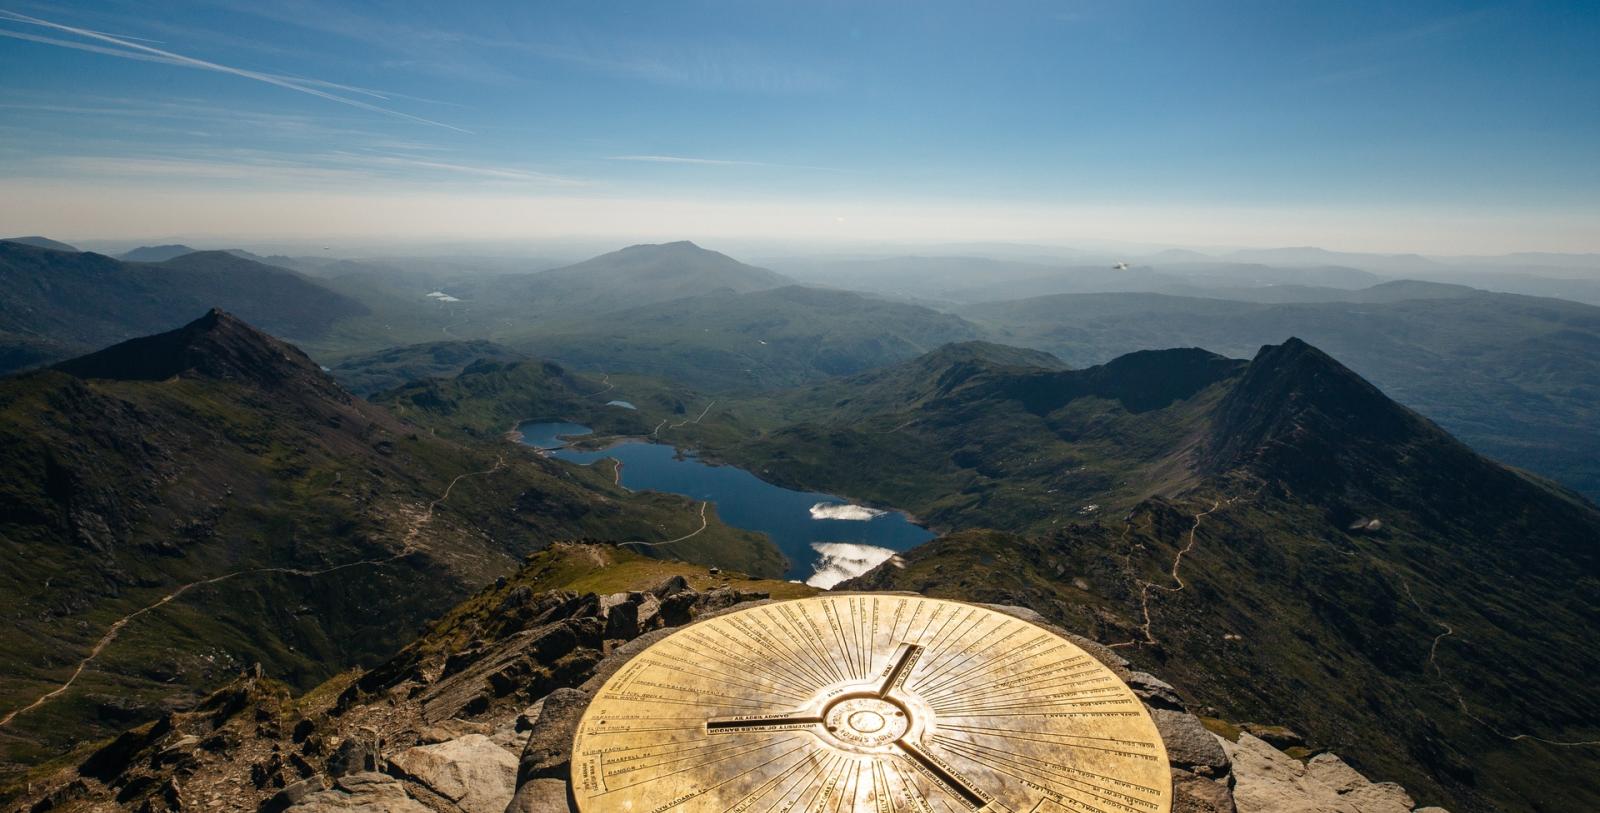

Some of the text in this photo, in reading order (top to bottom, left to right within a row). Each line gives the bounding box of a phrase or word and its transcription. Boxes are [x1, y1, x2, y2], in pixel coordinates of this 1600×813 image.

[946, 766, 974, 789] NATIONAL
[973, 786, 991, 801] PARK
[668, 792, 695, 807] PADARN
